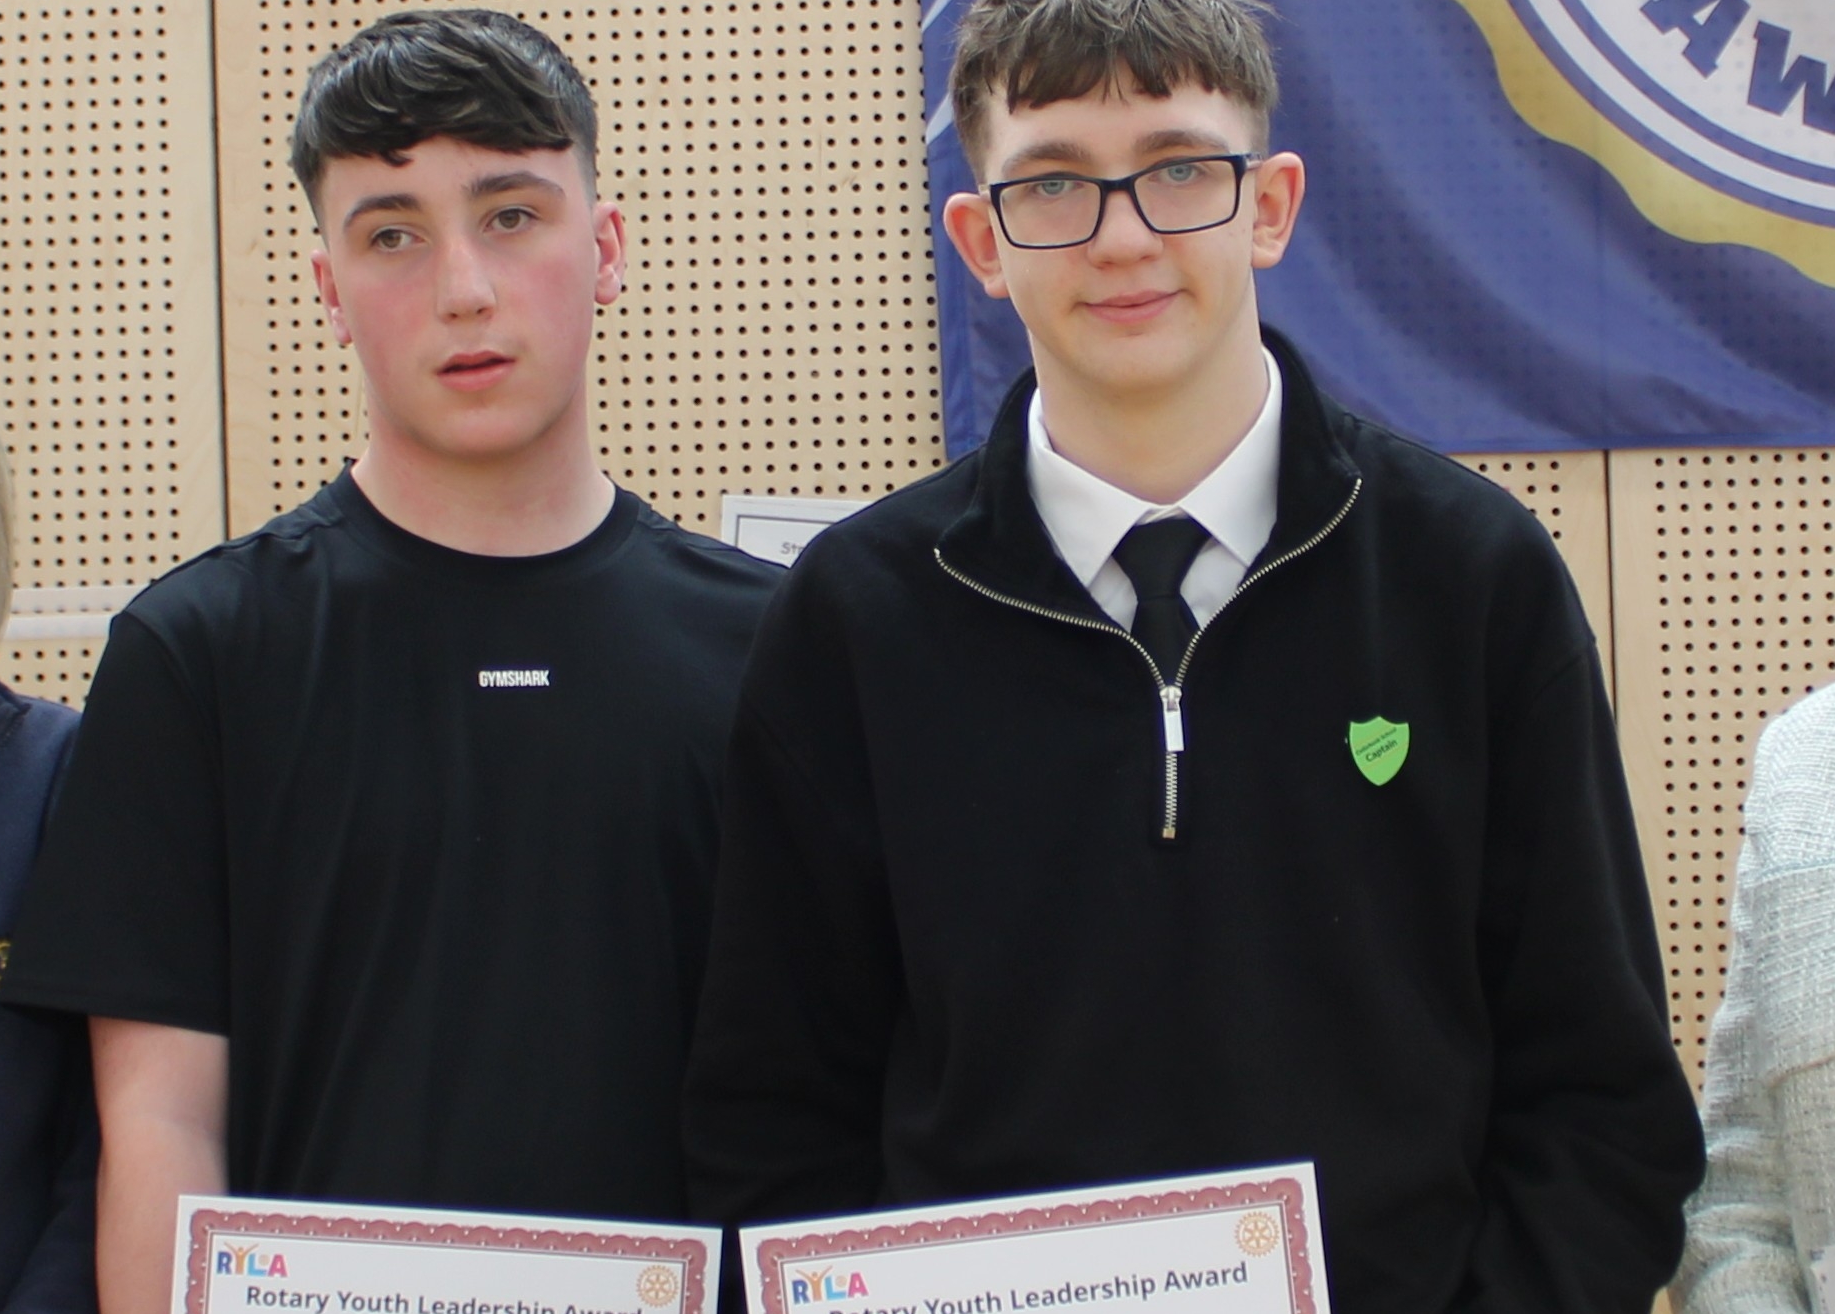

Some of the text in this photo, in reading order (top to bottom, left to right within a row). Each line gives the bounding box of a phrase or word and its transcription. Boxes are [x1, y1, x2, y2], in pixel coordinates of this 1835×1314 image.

[478, 669, 550, 687] GYMSHARK
[1365, 740, 1398, 762] Captain
[216, 1243, 288, 1277] RYLA
[792, 1265, 869, 1304] RYLA
[1011, 1274, 1156, 1311] Leadership
[1165, 1260, 1248, 1292] Award
[337, 1291, 409, 1314] Youth
